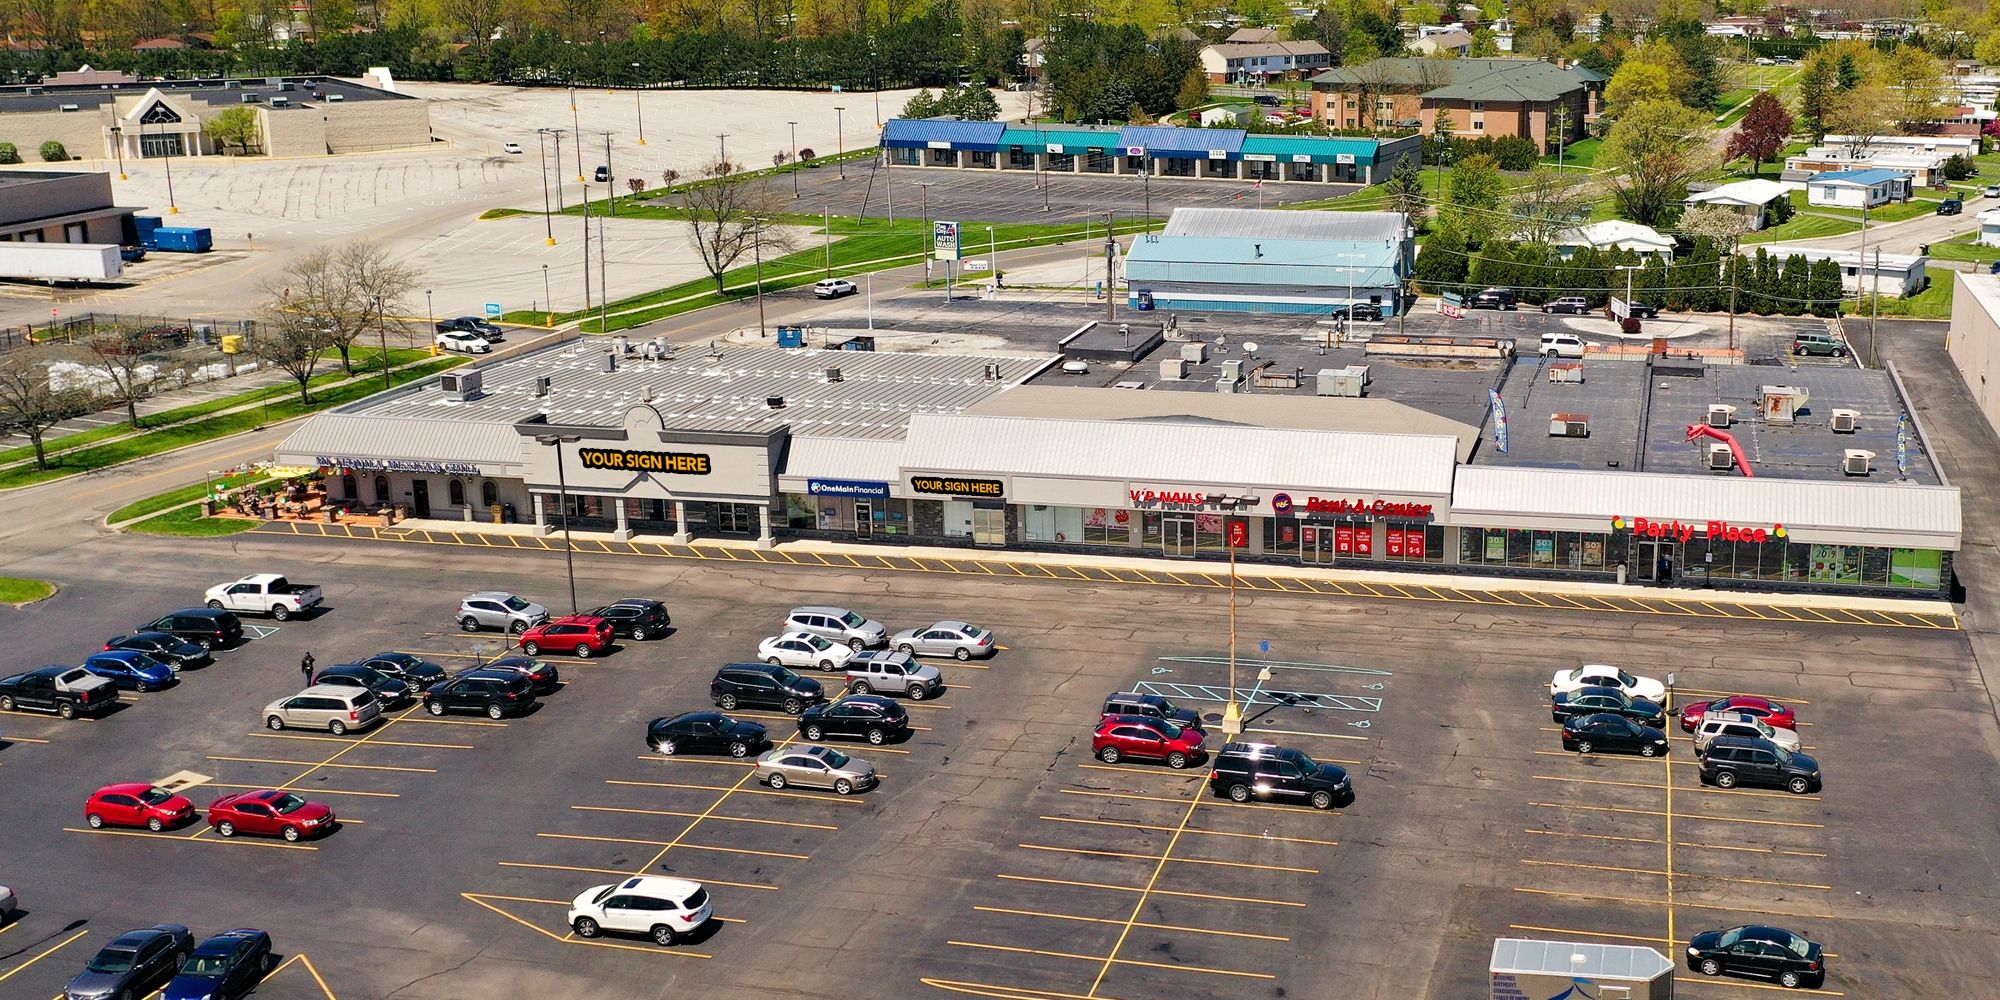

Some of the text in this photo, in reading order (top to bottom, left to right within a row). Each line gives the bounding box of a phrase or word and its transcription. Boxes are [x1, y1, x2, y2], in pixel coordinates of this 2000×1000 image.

[582, 452, 707, 472] YOUR SIGN HERE
[821, 484, 884, 494] OneMain Financial
[914, 480, 1000, 494] YOUR SIGN HERE
[1159, 491, 1204, 505] NAILS
[1276, 500, 1290, 508] RAC
[1634, 517, 1766, 542] Party Place
[1816, 550, 1836, 558] 2019
